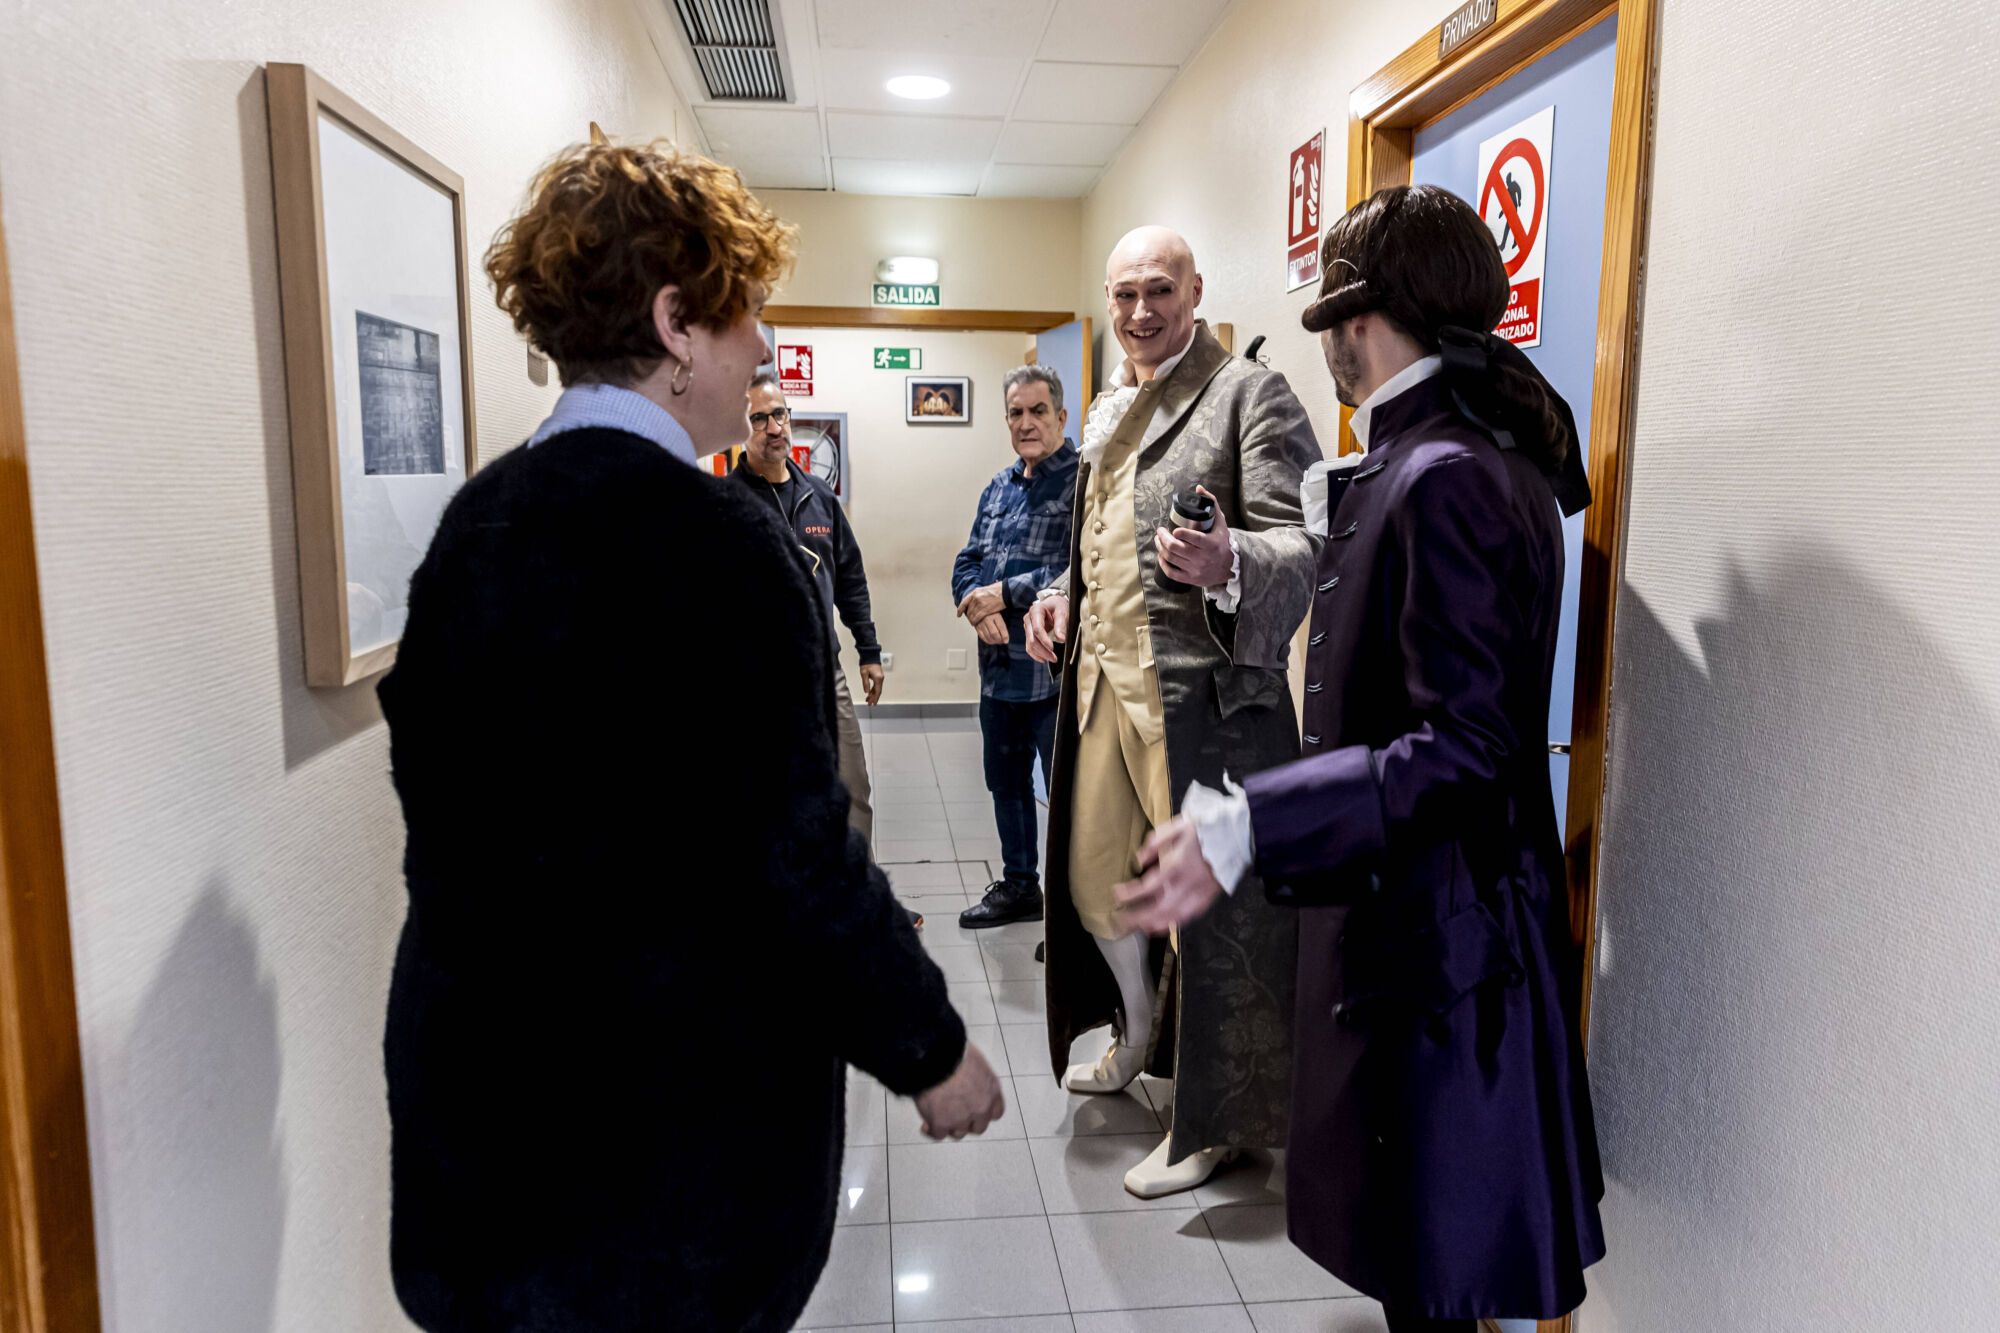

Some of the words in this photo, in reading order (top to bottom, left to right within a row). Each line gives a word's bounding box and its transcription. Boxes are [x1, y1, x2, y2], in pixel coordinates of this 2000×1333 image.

[1442, 0, 1491, 52] PRIVADO
[877, 286, 936, 304] SALIDA
[1499, 305, 1530, 325] ONAL
